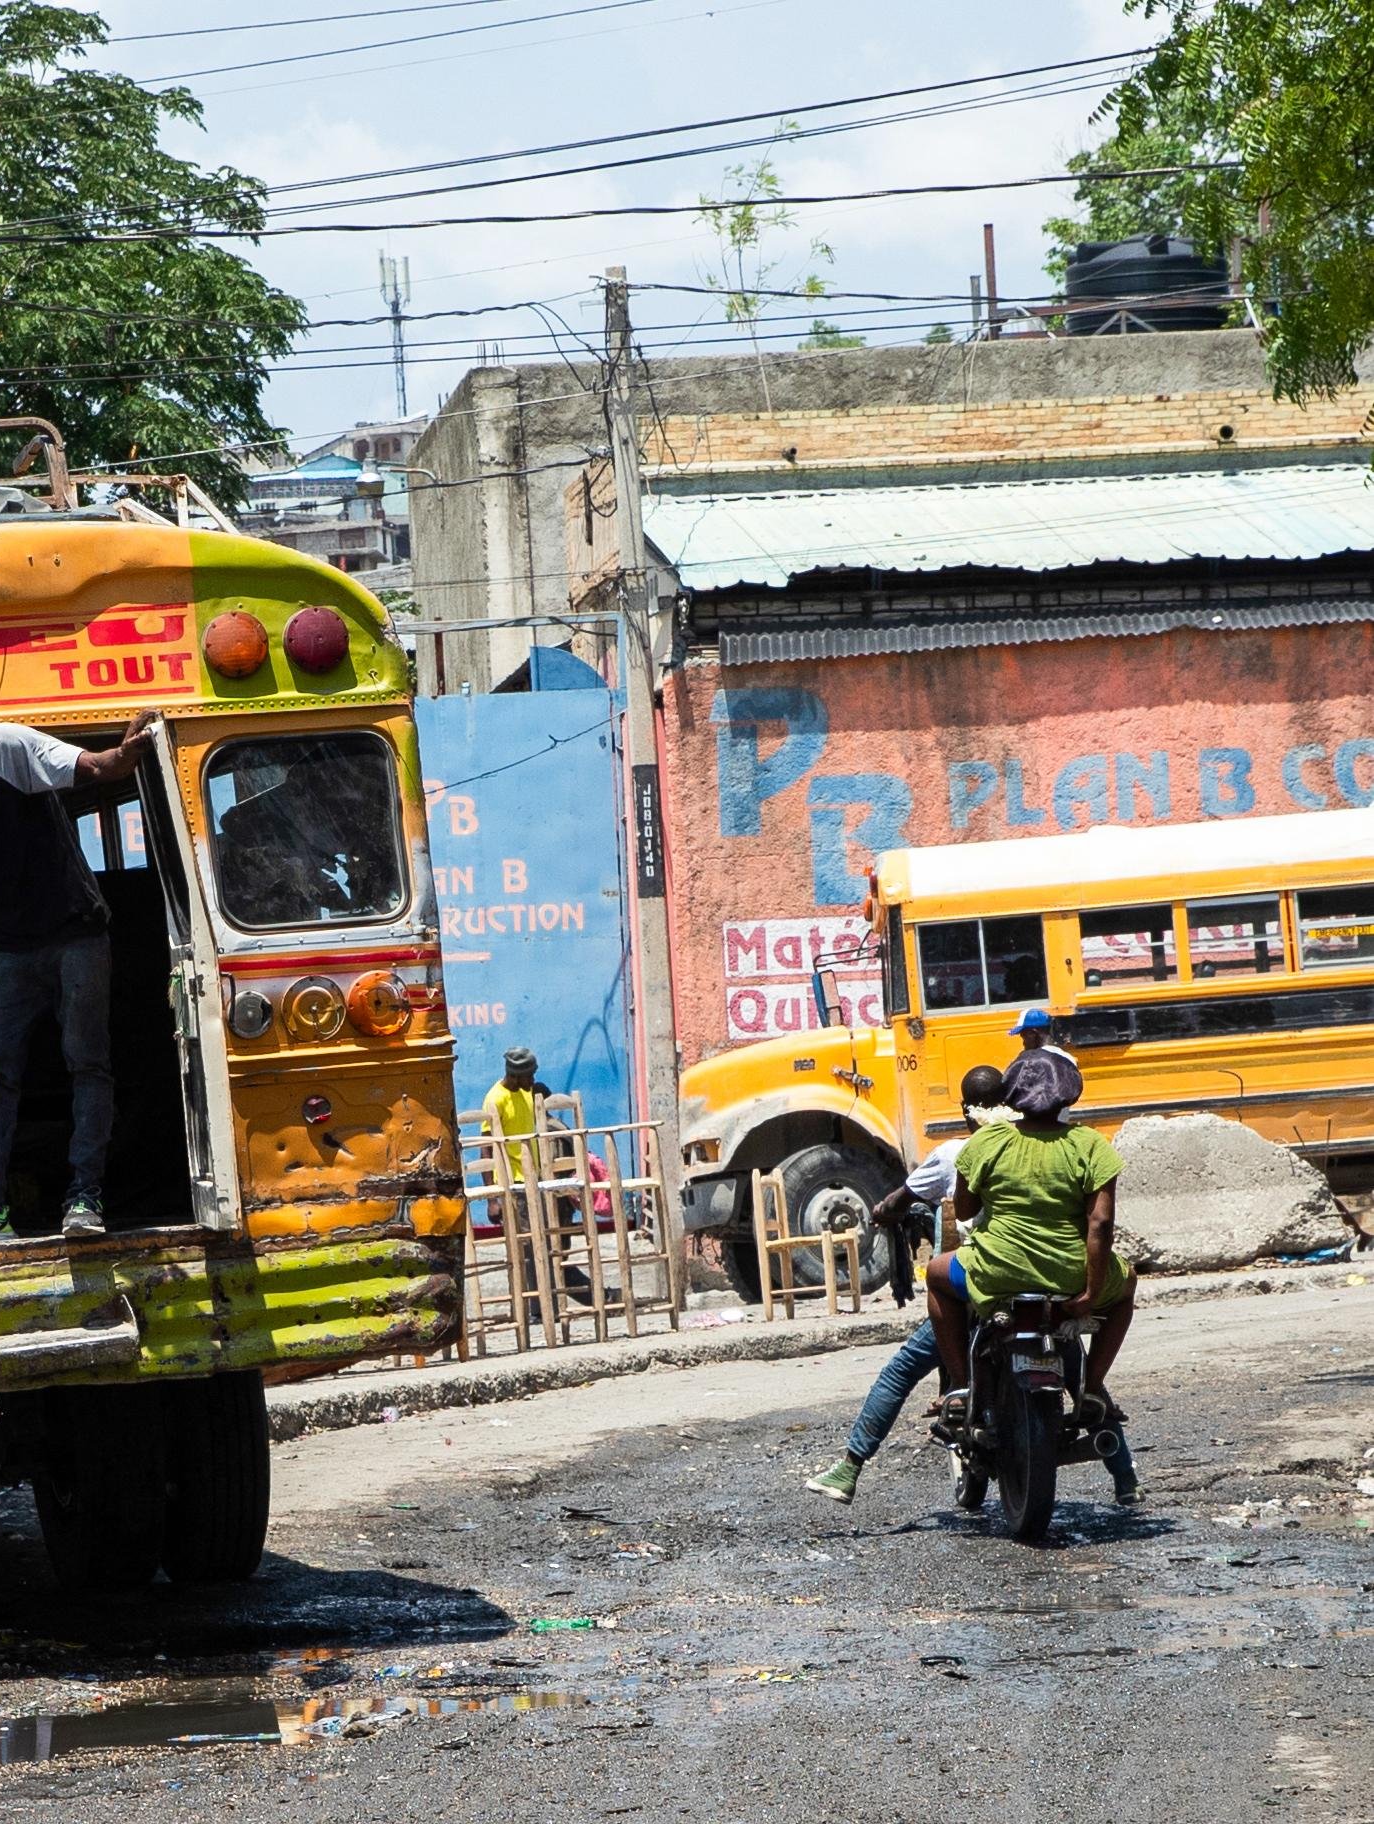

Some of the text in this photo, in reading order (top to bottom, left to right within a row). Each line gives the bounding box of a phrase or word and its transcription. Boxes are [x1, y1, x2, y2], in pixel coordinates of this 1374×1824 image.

[49, 652, 193, 690] TOUT
[947, 750, 1171, 830] PLAN
[1198, 747, 1257, 816] B
[501, 857, 529, 894] B
[440, 902, 585, 938] RUCTION
[448, 1002, 506, 1027] KING
